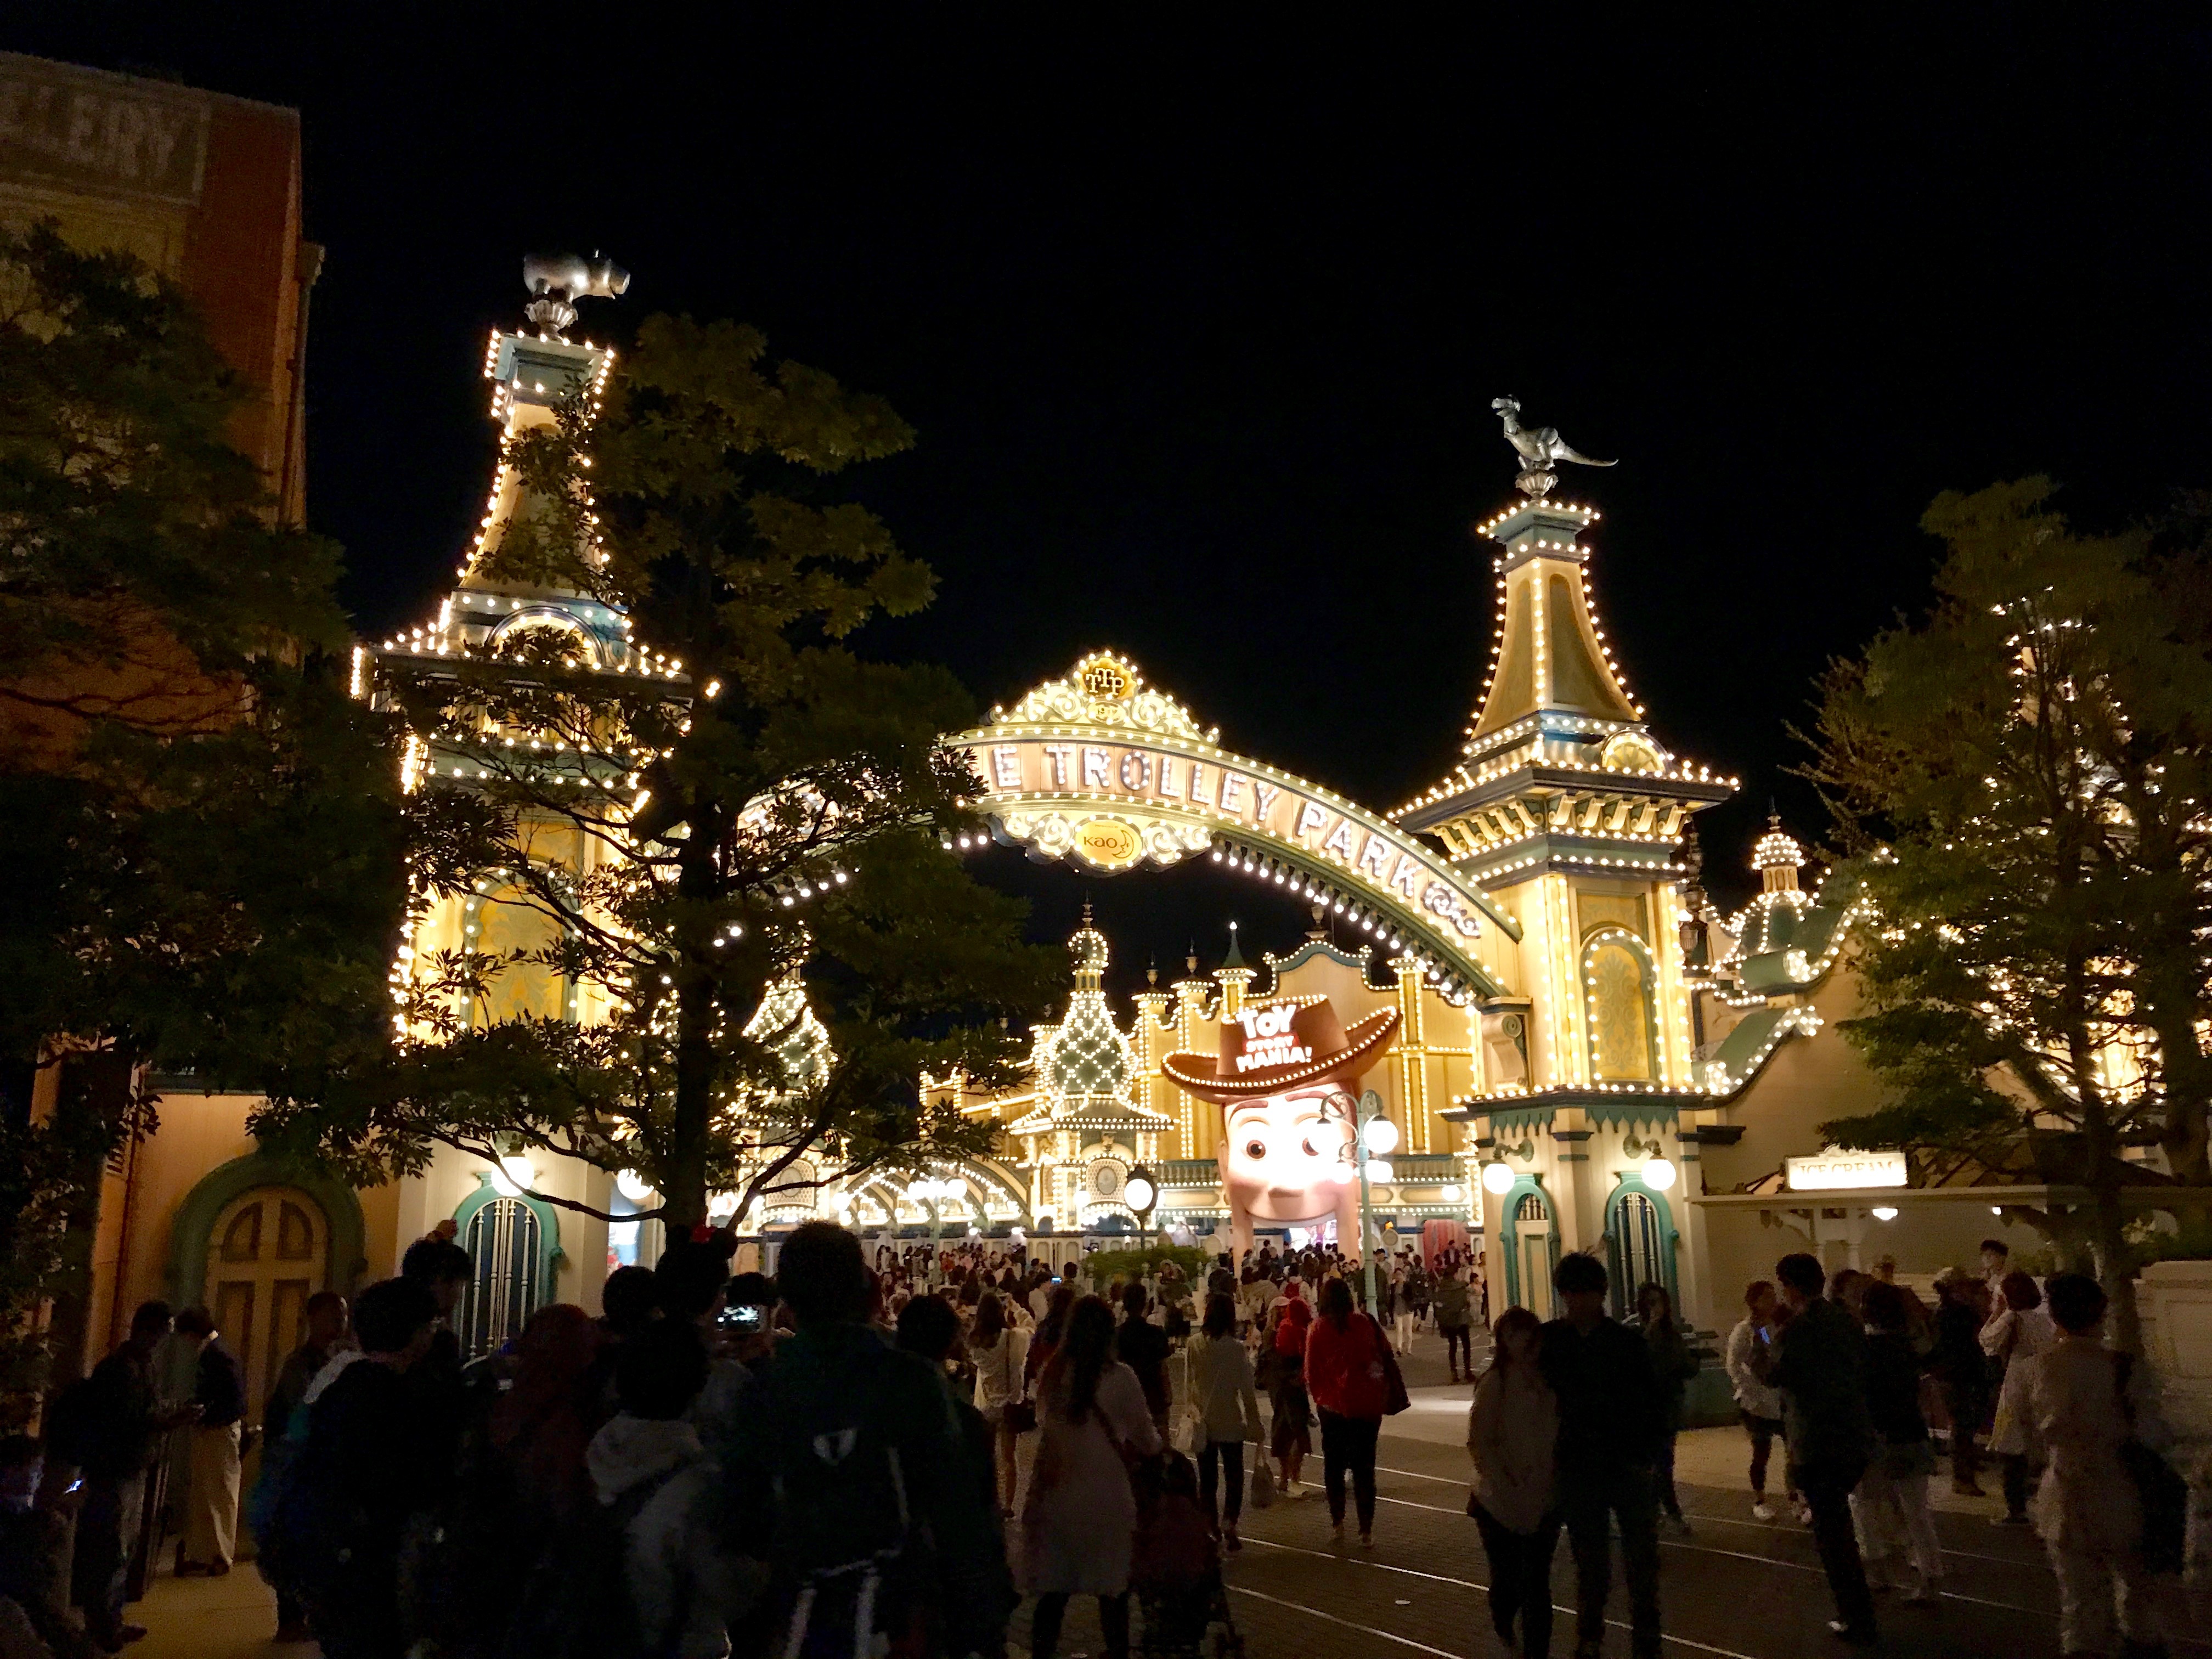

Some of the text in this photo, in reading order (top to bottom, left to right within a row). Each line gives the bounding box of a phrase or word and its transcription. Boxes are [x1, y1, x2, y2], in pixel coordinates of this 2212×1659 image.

[1086, 667, 1125, 696] TTP
[1046, 744, 1279, 821] TROLLEY
[1296, 799, 1425, 898] PARK
[1235, 1004, 1297, 1039] TOY
[1246, 1035, 1294, 1053] STORY
[1235, 1046, 1313, 1073] MANIA!
[1800, 1163, 1827, 1177] ICE
